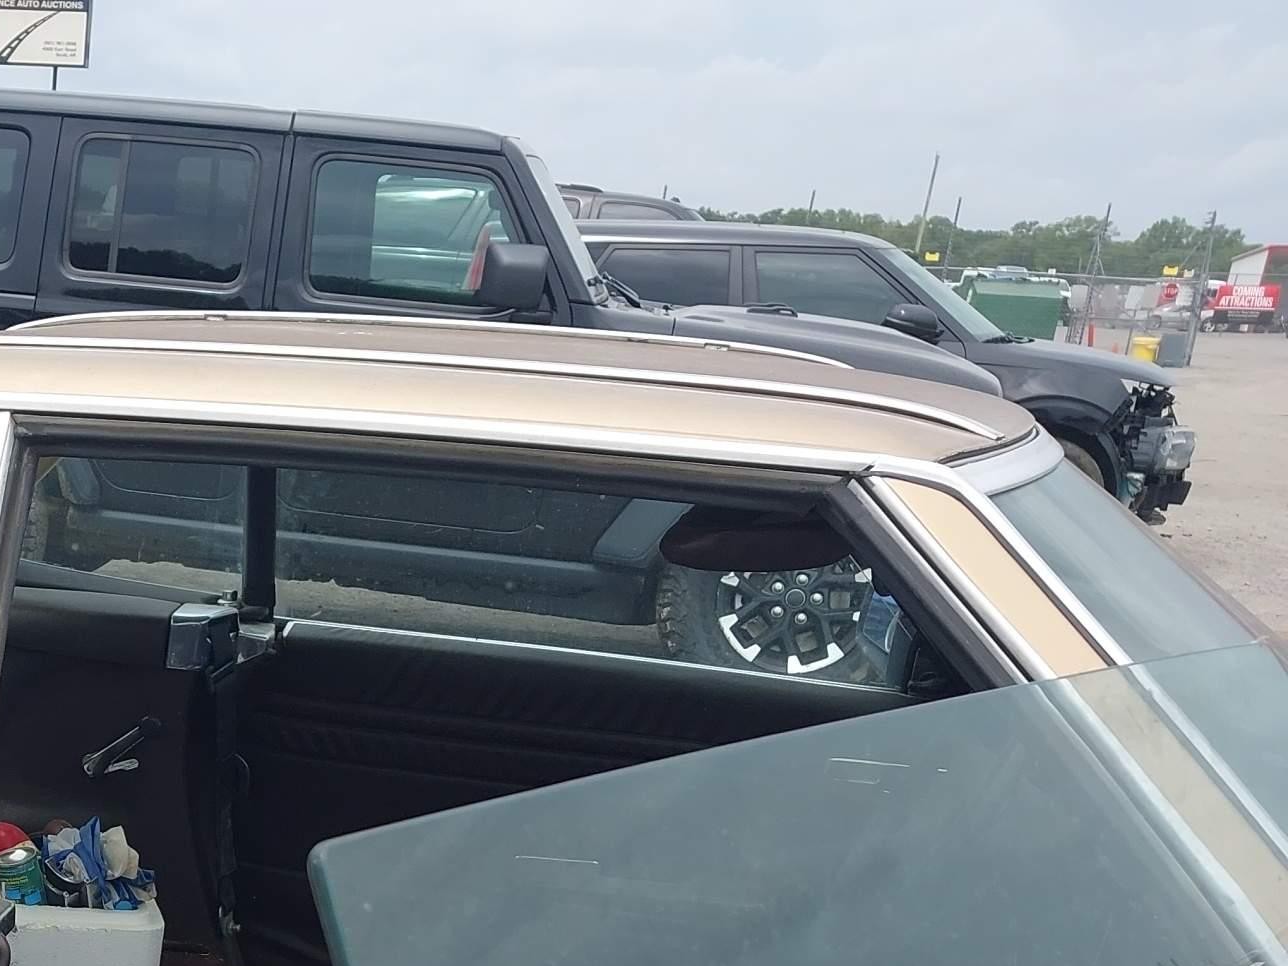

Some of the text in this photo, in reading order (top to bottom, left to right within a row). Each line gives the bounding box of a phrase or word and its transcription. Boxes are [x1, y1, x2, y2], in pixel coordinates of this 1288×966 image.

[17, 0, 40, 8] AUTO
[41, 0, 84, 9] AUCTIONS
[1232, 286, 1265, 297] COMING
[1218, 295, 1274, 307] ATTRACTIONS
